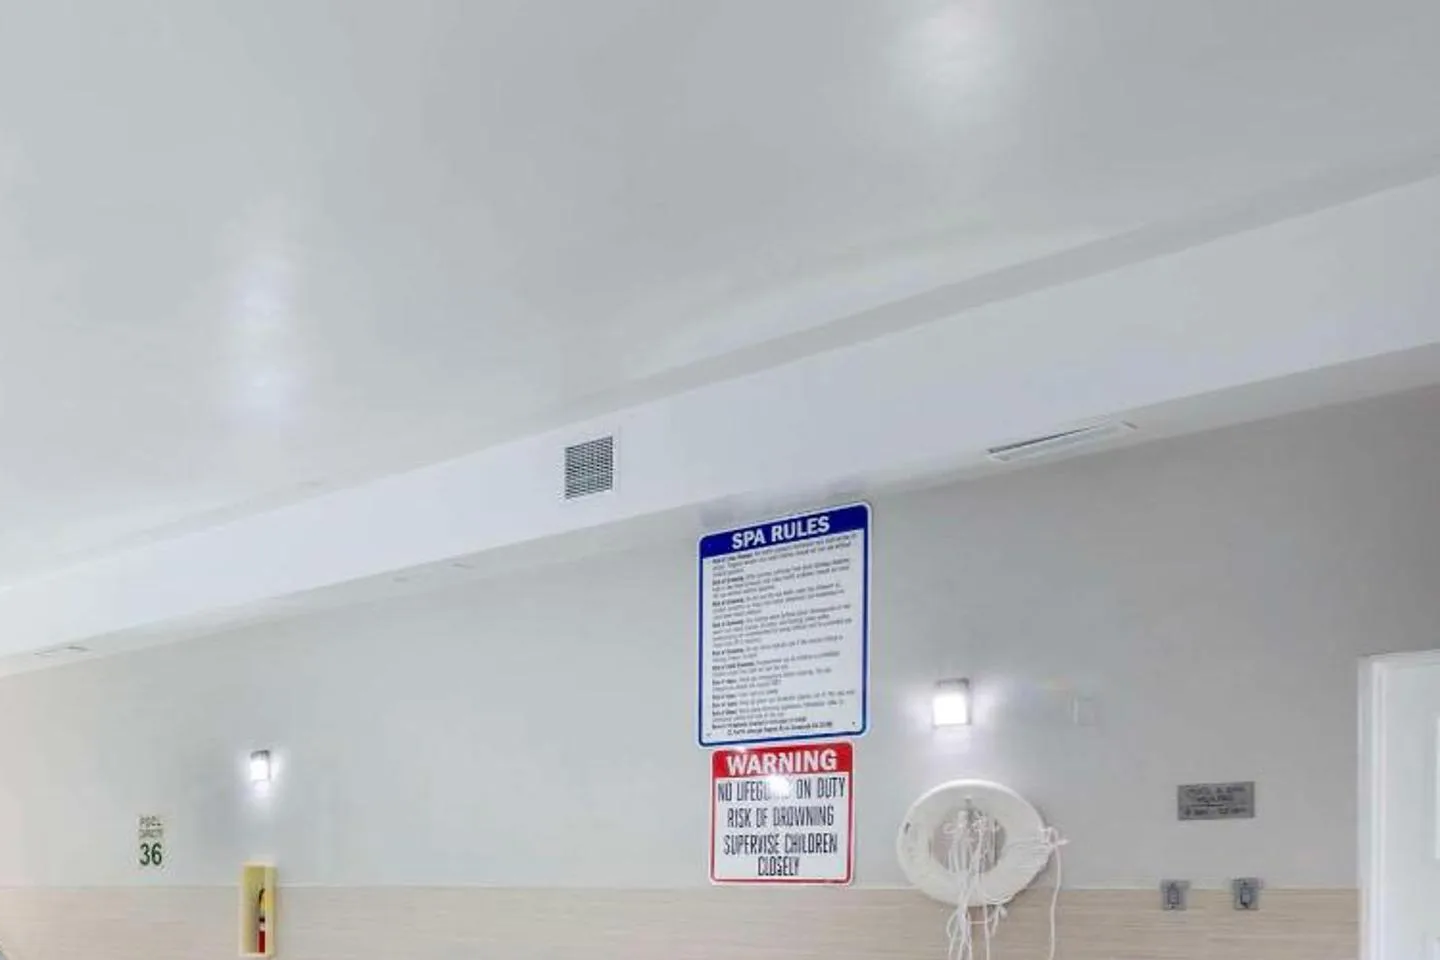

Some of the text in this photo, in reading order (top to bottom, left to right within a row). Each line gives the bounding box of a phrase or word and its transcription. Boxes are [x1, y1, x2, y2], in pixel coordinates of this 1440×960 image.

[731, 514, 830, 551] SPA RULES
[725, 748, 838, 777] WARNING
[717, 781, 733, 802] NO
[796, 778, 812, 800] ON
[817, 776, 846, 799] DUTY
[727, 804, 835, 829] RISK OF DROWNING
[139, 842, 163, 867] 36
[723, 832, 838, 856] SUPERVISE CHILDREN
[757, 855, 800, 877] CLOSELY
